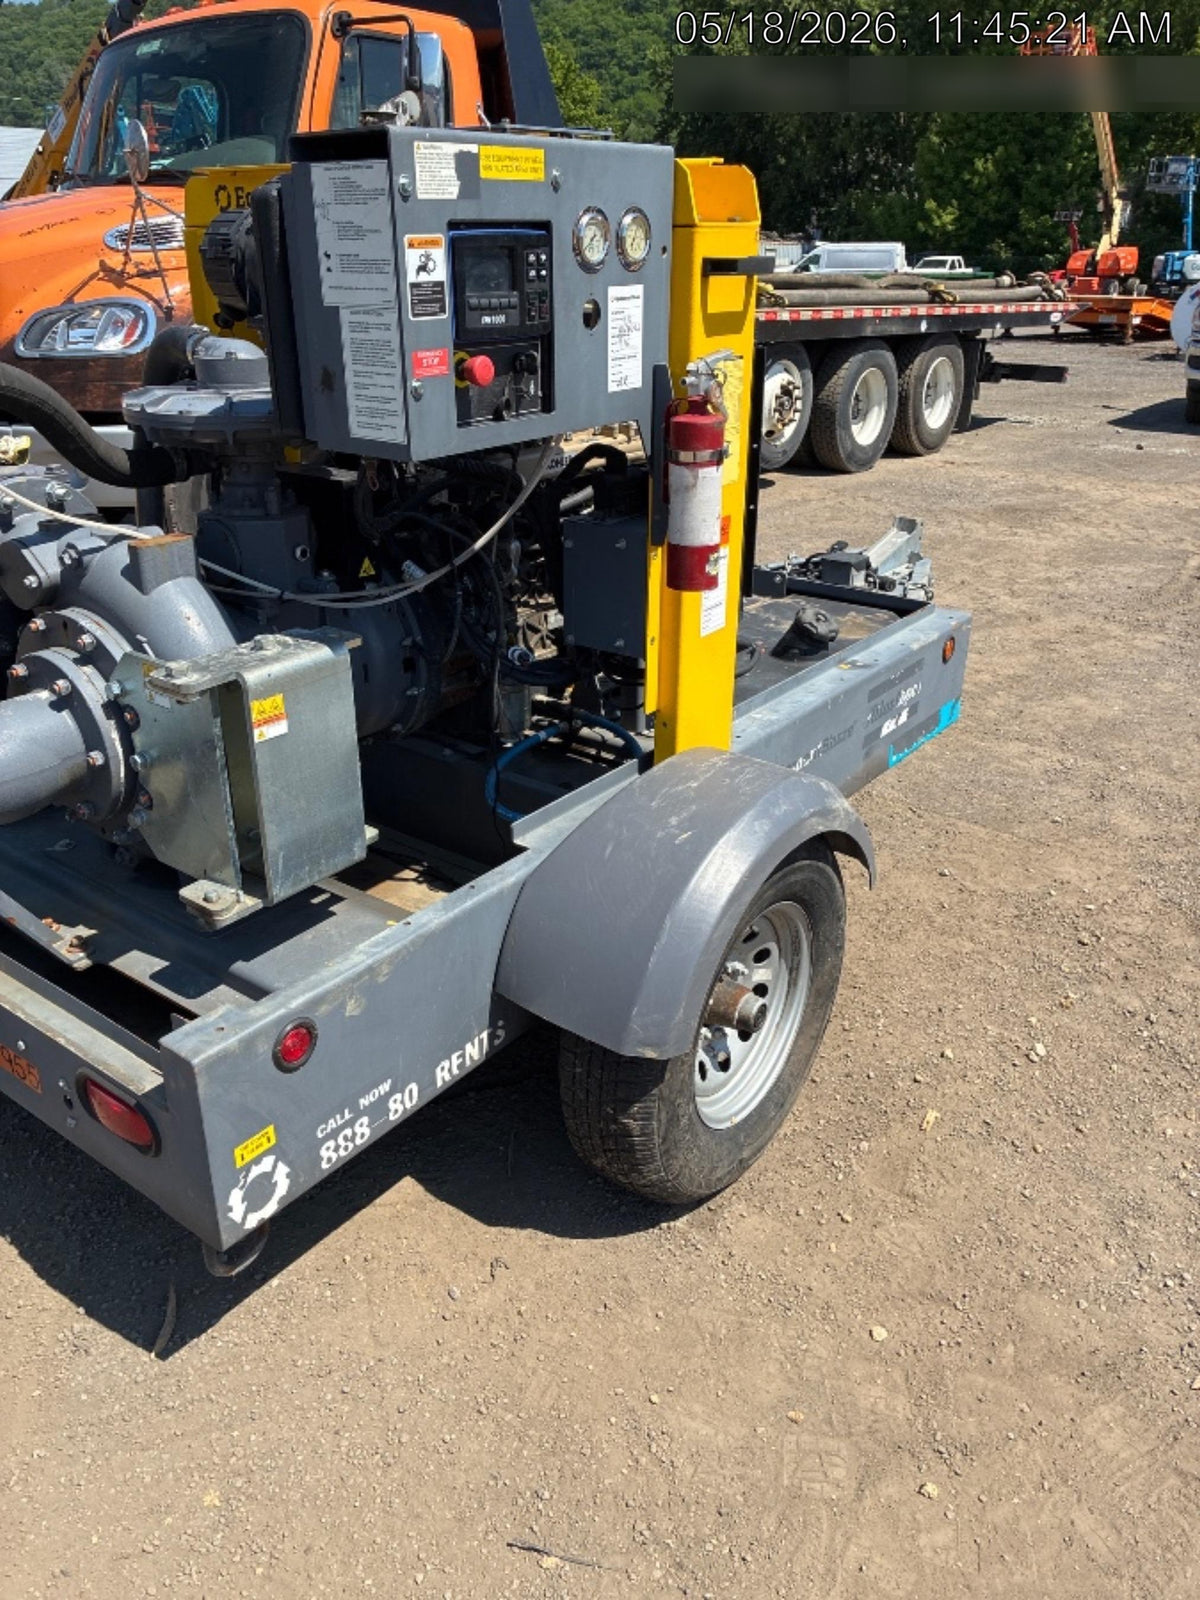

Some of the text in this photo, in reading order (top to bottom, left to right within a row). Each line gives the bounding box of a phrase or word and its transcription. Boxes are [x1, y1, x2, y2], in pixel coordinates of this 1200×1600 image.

[316, 1078, 392, 1138] CALL NOW
[319, 1116, 371, 1169] 888
[388, 1082, 419, 1121] 80
